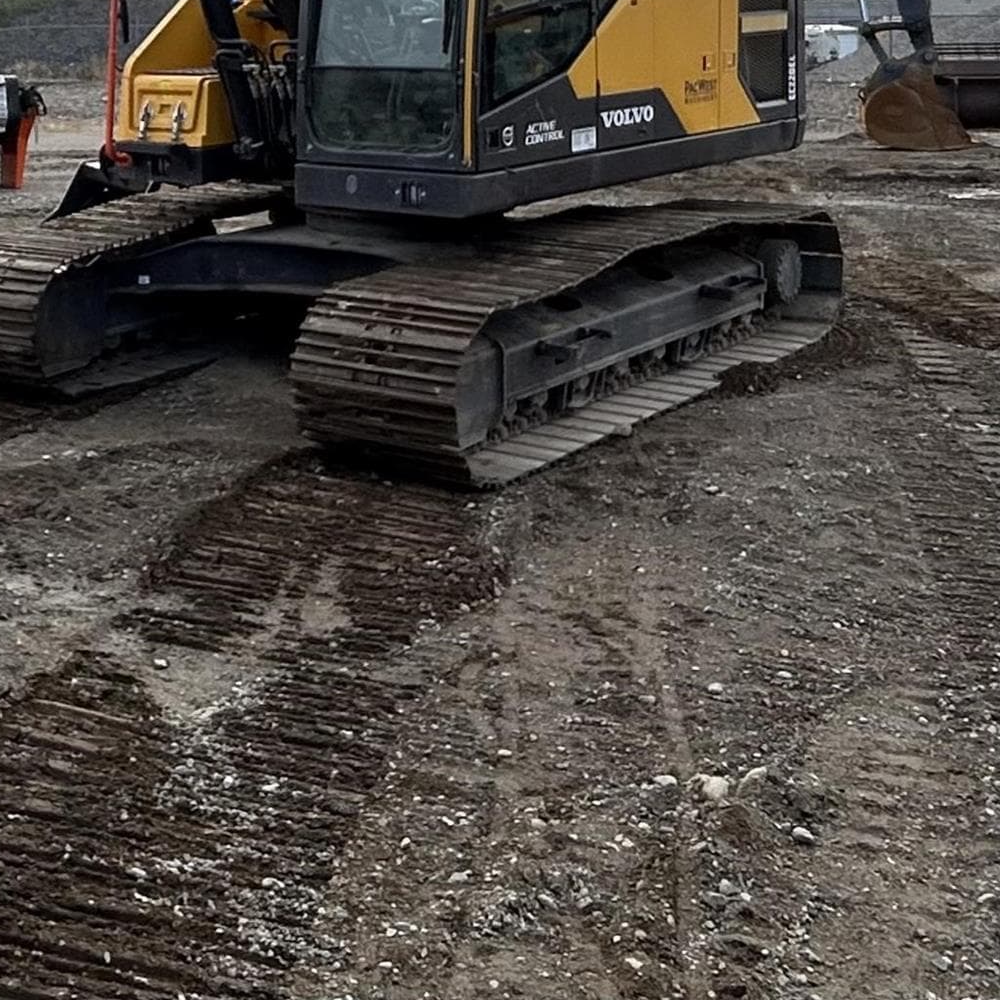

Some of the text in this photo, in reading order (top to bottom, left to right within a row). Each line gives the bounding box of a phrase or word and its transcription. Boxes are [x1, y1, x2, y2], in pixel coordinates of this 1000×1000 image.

[600, 105, 654, 128] VOLVO
[526, 120, 557, 134] ACTIVE
[525, 129, 565, 146] CONTROL
